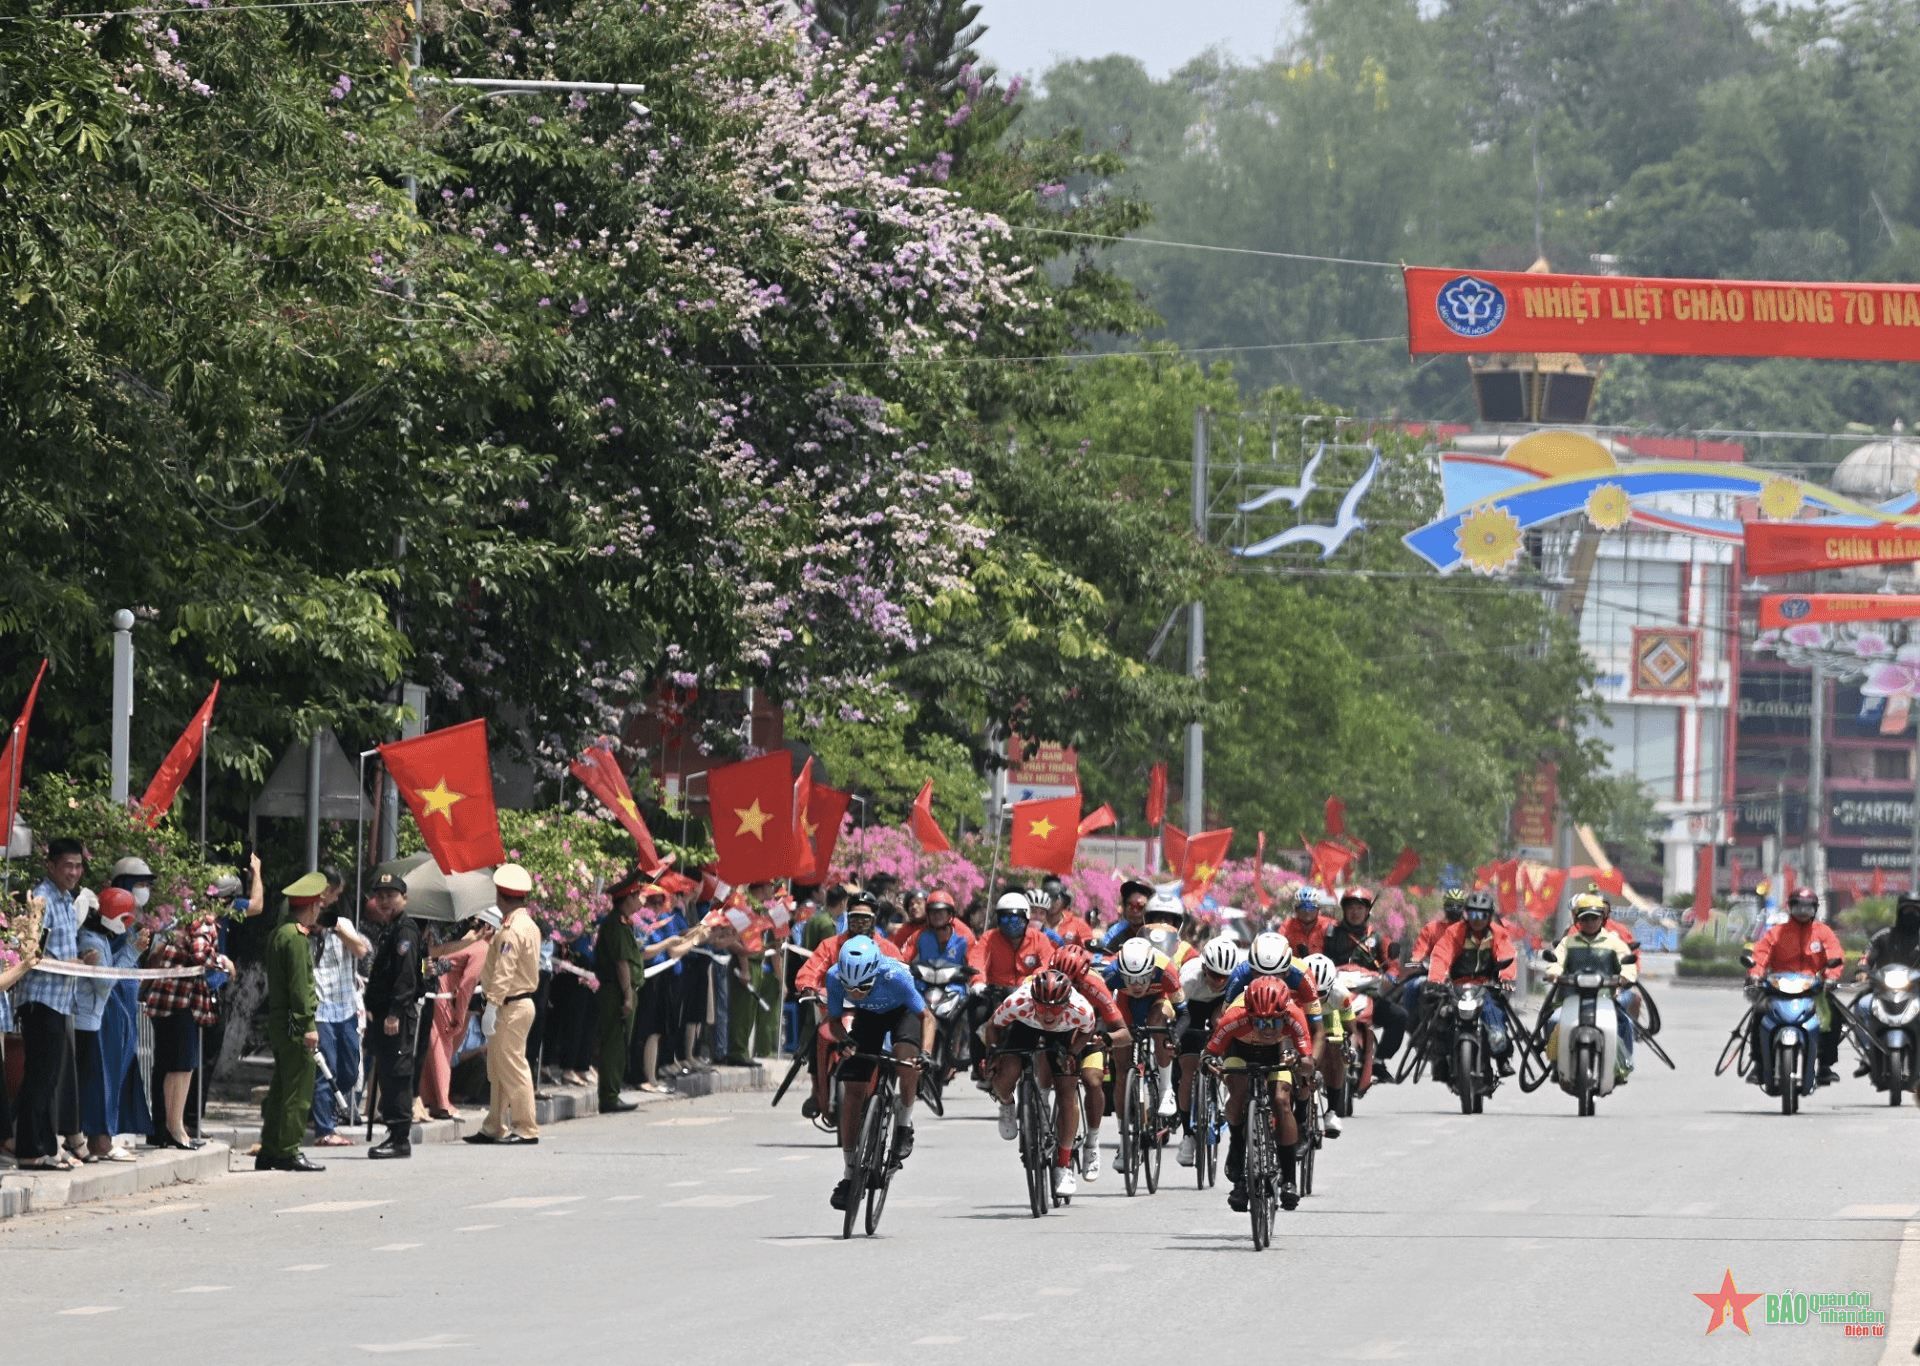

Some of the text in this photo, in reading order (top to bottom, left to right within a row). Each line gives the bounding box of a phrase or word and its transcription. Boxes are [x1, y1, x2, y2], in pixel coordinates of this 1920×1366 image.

[1523, 281, 1601, 325] NHIỆT
[1610, 282, 1664, 326] LIỆT
[1840, 291, 1875, 325] 70
